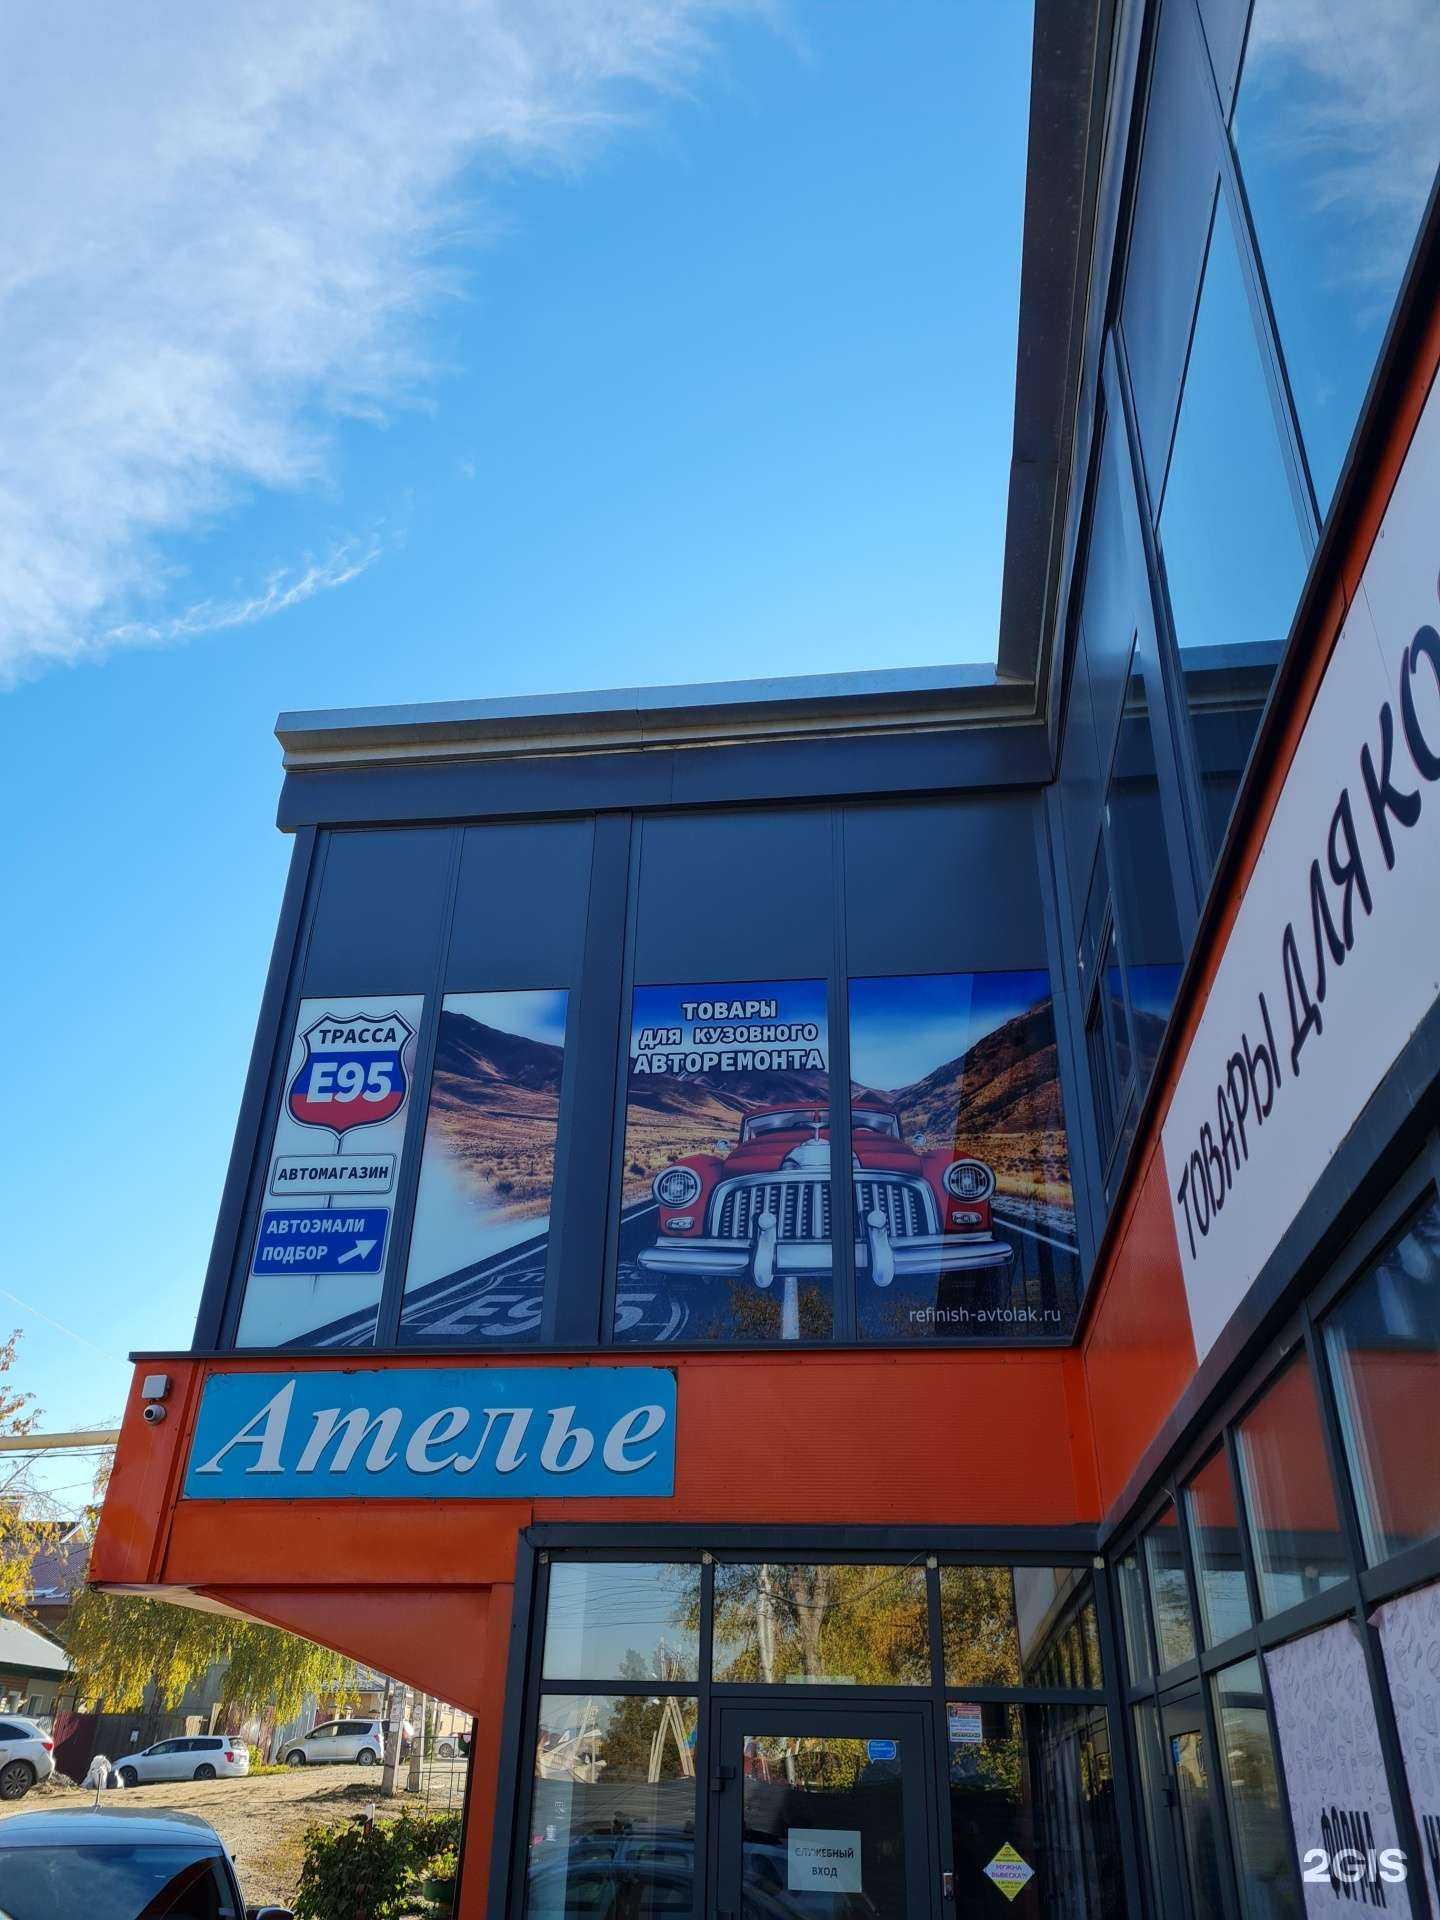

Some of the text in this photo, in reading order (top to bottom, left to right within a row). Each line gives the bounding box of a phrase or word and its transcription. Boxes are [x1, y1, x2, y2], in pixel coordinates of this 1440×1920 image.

[1177, 565, 1440, 1260] ТОВАРЫ ДЛЯ КО
[683, 1000, 777, 1021] ТОВАРЫ
[319, 1027, 398, 1045] ТРАССА
[639, 1023, 818, 1050] ДЛЯ КУЗОВНОГО
[633, 1048, 826, 1075] АВТОРЕМОНТА
[306, 1062, 394, 1103] Е95
[277, 1166, 389, 1181] АВТОМАГАЗИН
[266, 1218, 365, 1234] АВТОЭМАЛИ
[262, 1246, 328, 1264] ПОДБОР
[909, 1307, 1061, 1322] refinish-avtolak.ru
[195, 1378, 666, 1475] Ателье
[795, 1847, 854, 1859] СЛУЖЕБНЫЙ
[812, 1866, 838, 1878] ВХОД
